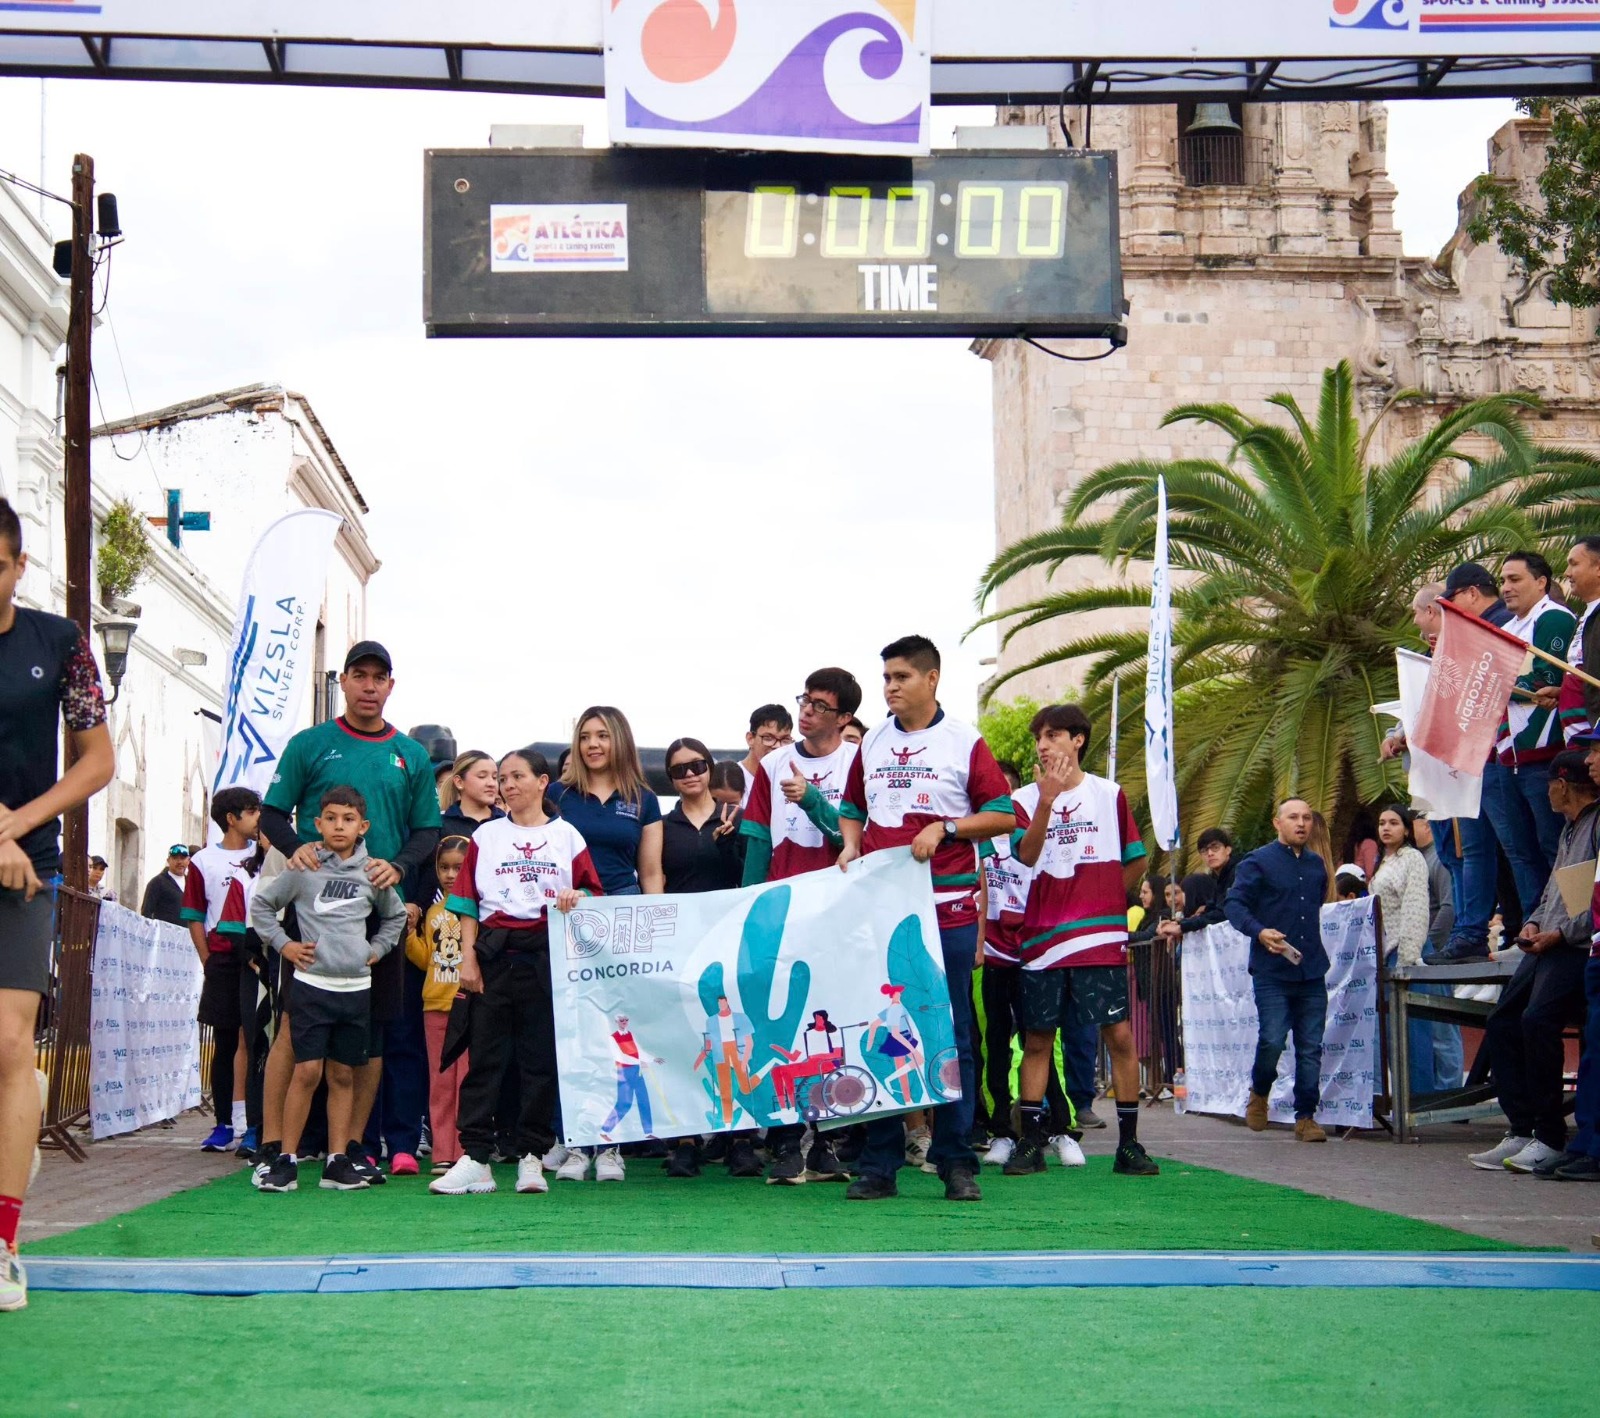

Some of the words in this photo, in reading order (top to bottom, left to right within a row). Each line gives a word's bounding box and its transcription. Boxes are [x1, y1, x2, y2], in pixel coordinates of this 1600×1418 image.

[858, 265, 937, 311] TIME
[251, 597, 296, 716] VIZSLA
[272, 659, 296, 721] SILVER
[290, 601, 307, 651] CORP.
[869, 771, 885, 781] SAN
[886, 771, 939, 781] SEBASTIAN
[887, 778, 912, 789] 2026
[1056, 826, 1099, 837] SEBASTIAN
[1058, 835, 1078, 845] 2026
[495, 867, 514, 876] SAN
[320, 880, 360, 899] NIKE
[430, 909, 451, 929] ONE
[563, 903, 678, 960] DIF
[433, 966, 460, 984] KIND
[567, 960, 674, 982] CONCORDIA
